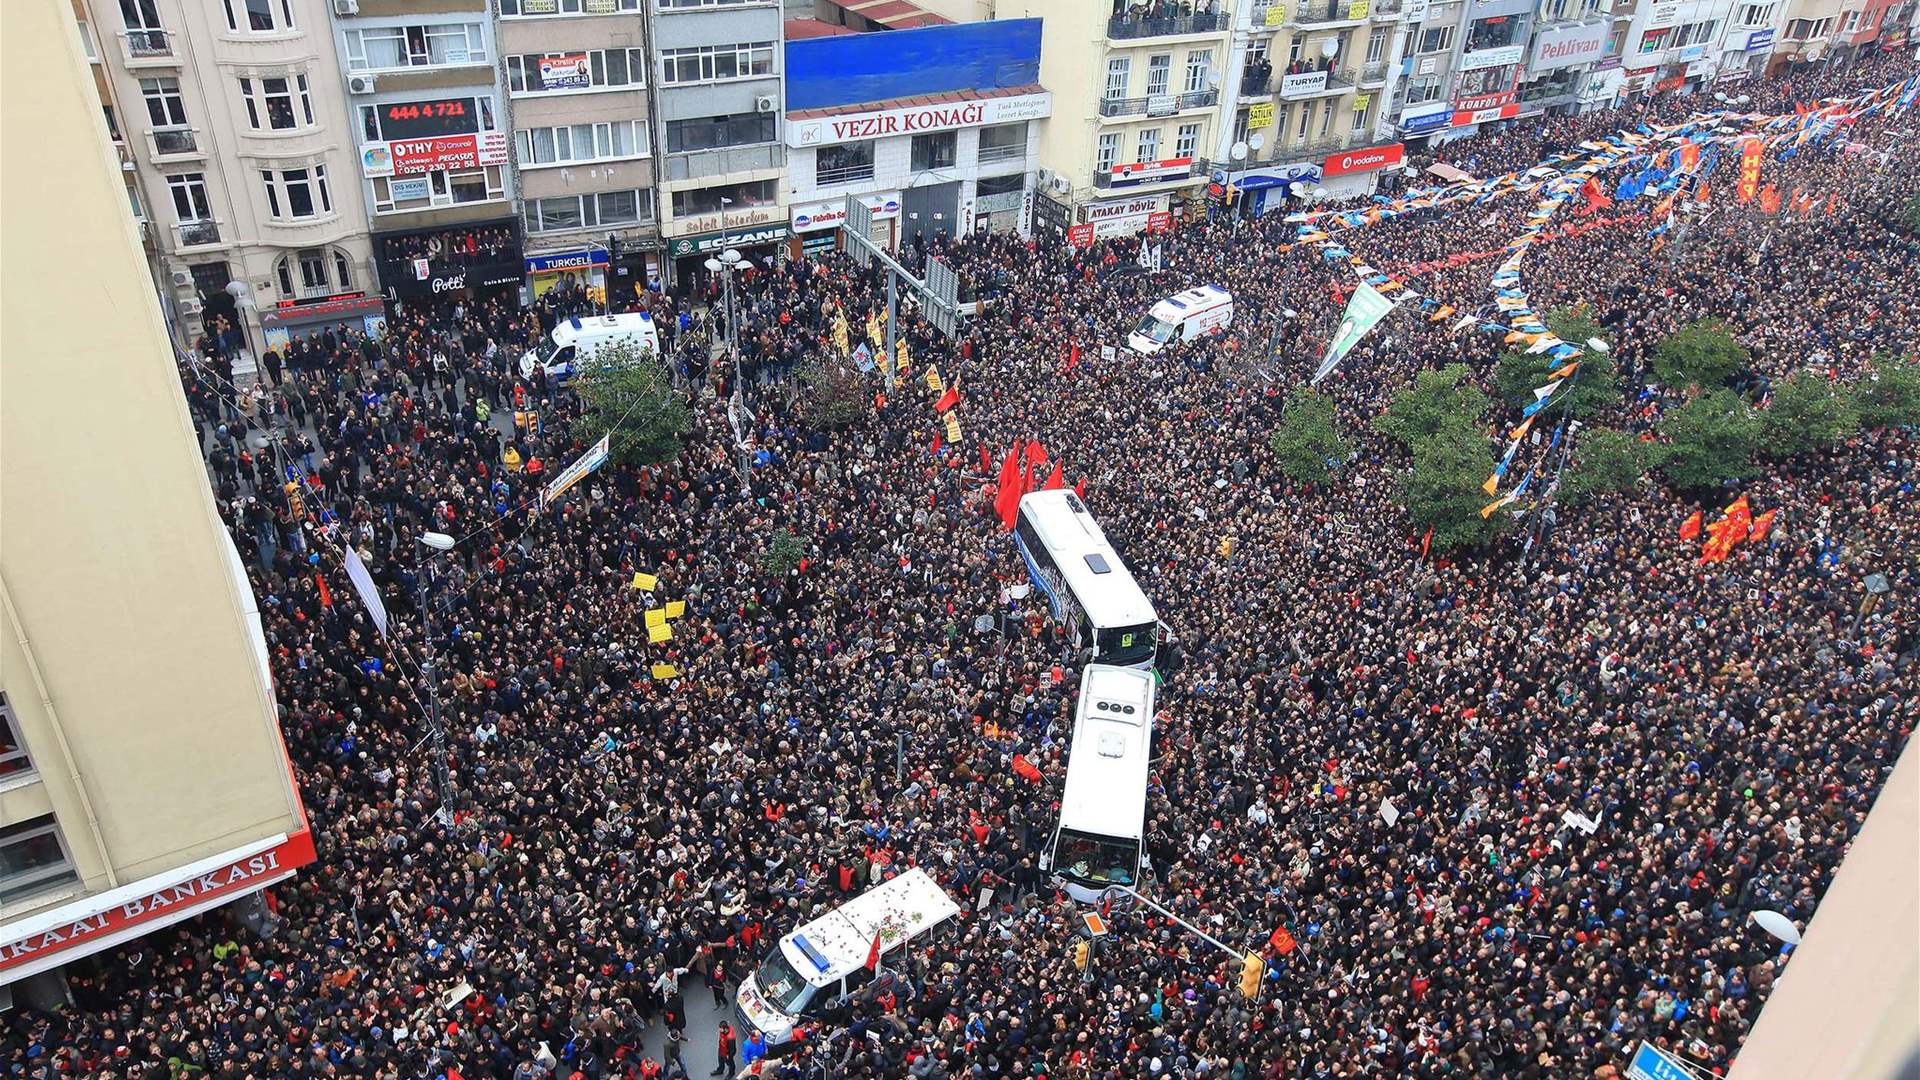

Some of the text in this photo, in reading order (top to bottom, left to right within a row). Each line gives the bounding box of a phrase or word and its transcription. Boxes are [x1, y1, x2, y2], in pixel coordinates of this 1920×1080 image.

[1540, 38, 1599, 60] Pehlivan
[1290, 76, 1325, 86] TURYAP
[389, 102, 465, 120] 444 4 721
[832, 104, 986, 139] VEZİR KONAĞI
[438, 152, 474, 162] PEGASUS
[1353, 155, 1385, 166] vodafone
[403, 165, 426, 174] 0212
[429, 163, 446, 172] 230
[449, 161, 461, 169] 22
[812, 213, 836, 223] Fabrika
[1091, 200, 1156, 219] ATAKAY DÖVİZ
[698, 228, 787, 250] ECZANE
[122, 850, 281, 921] BANKASI
